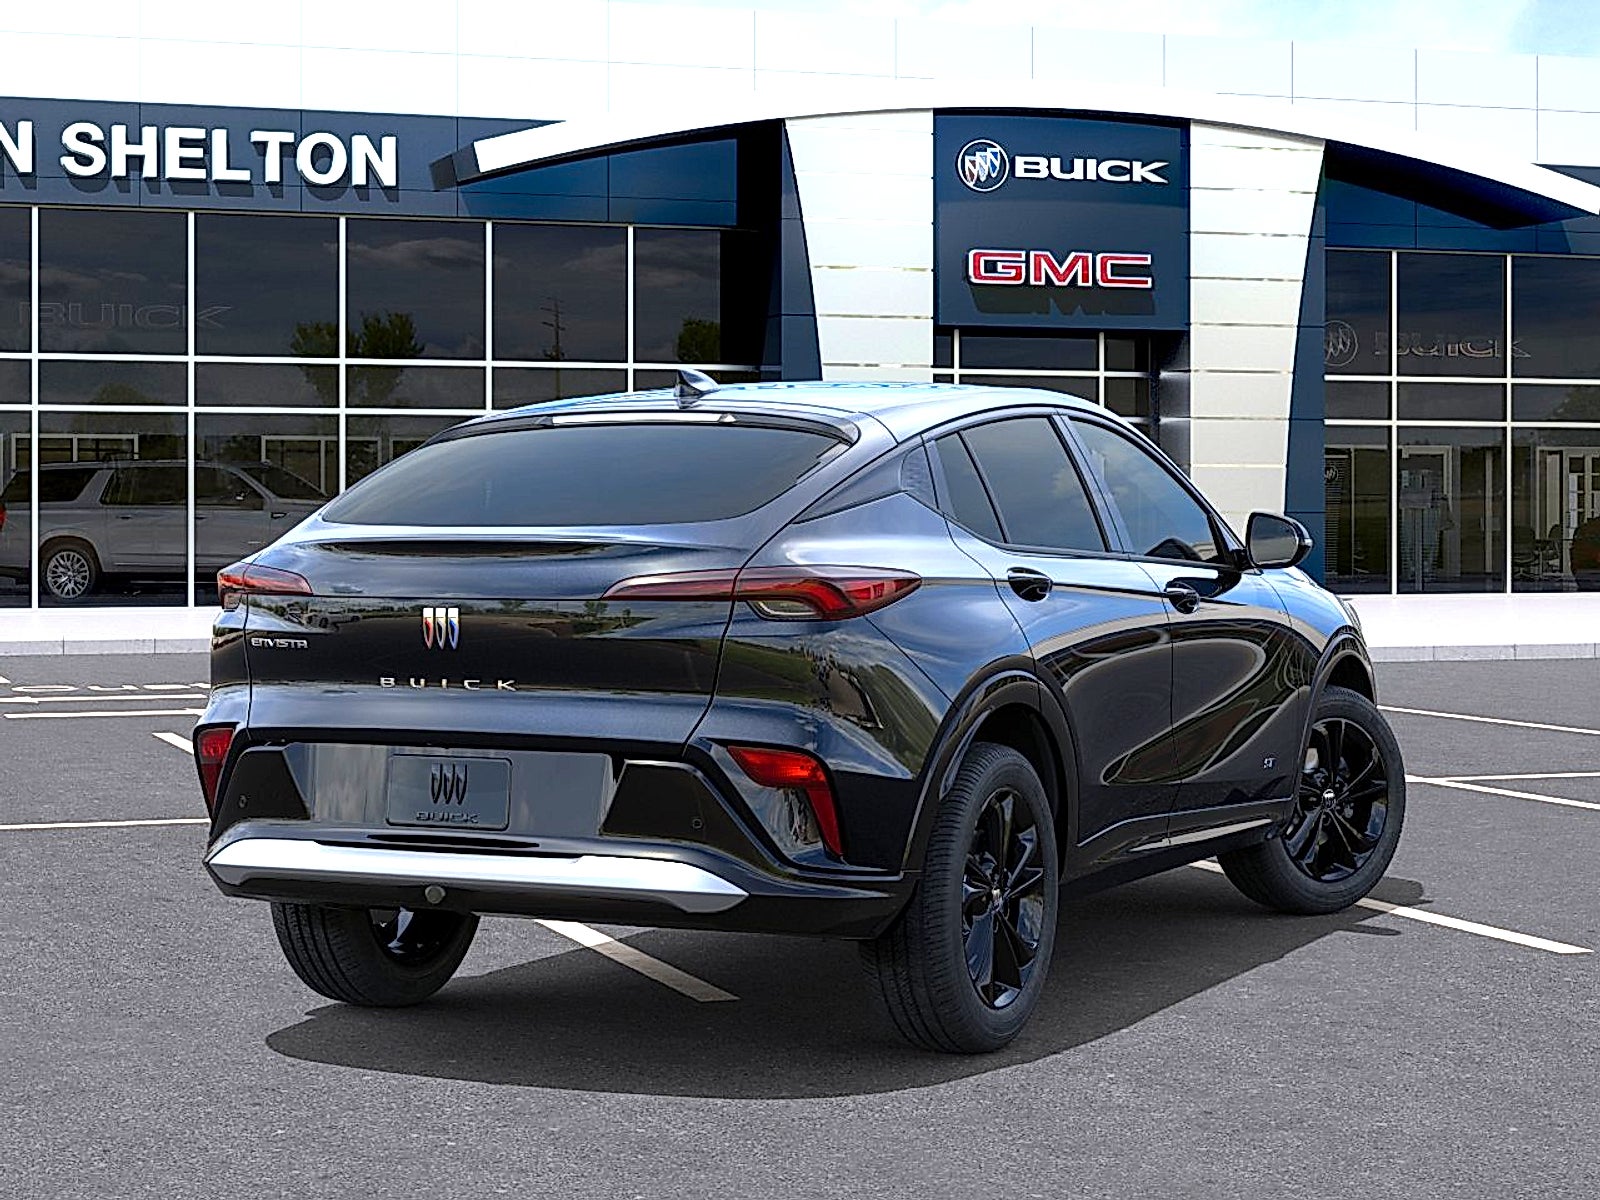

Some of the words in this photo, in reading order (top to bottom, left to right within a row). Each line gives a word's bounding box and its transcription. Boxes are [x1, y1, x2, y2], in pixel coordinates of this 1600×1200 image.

[60, 122, 397, 187] SHELTON
[1014, 155, 1169, 184] BUICK
[968, 250, 1152, 288] GMC
[251, 637, 308, 649] ENVISTA
[379, 677, 516, 691] BUICK
